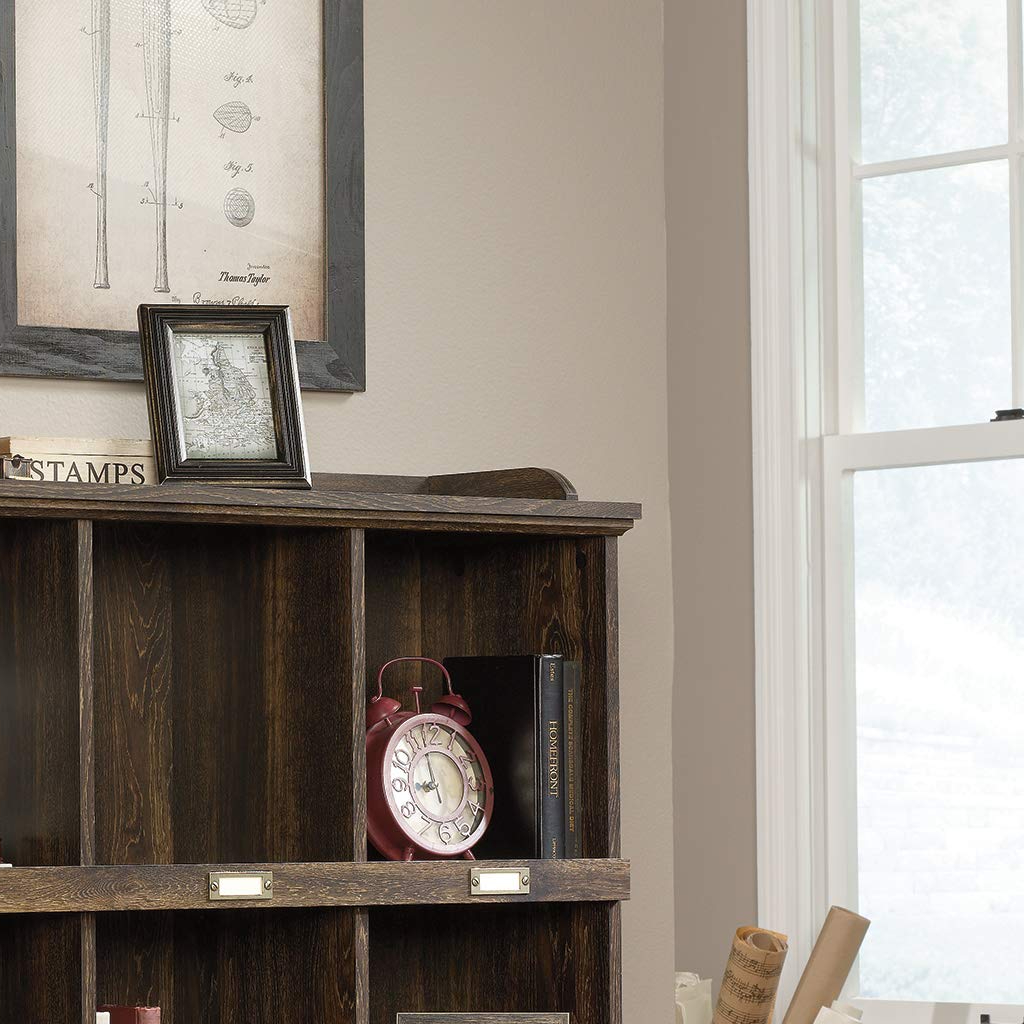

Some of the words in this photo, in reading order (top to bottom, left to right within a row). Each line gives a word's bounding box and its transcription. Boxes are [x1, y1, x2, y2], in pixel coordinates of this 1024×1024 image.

[218, 271, 247, 283] Thomas
[247, 272, 271, 287] Taylor
[30, 460, 145, 485] STAMPS
[548, 720, 559, 798] HOMEFRONT
